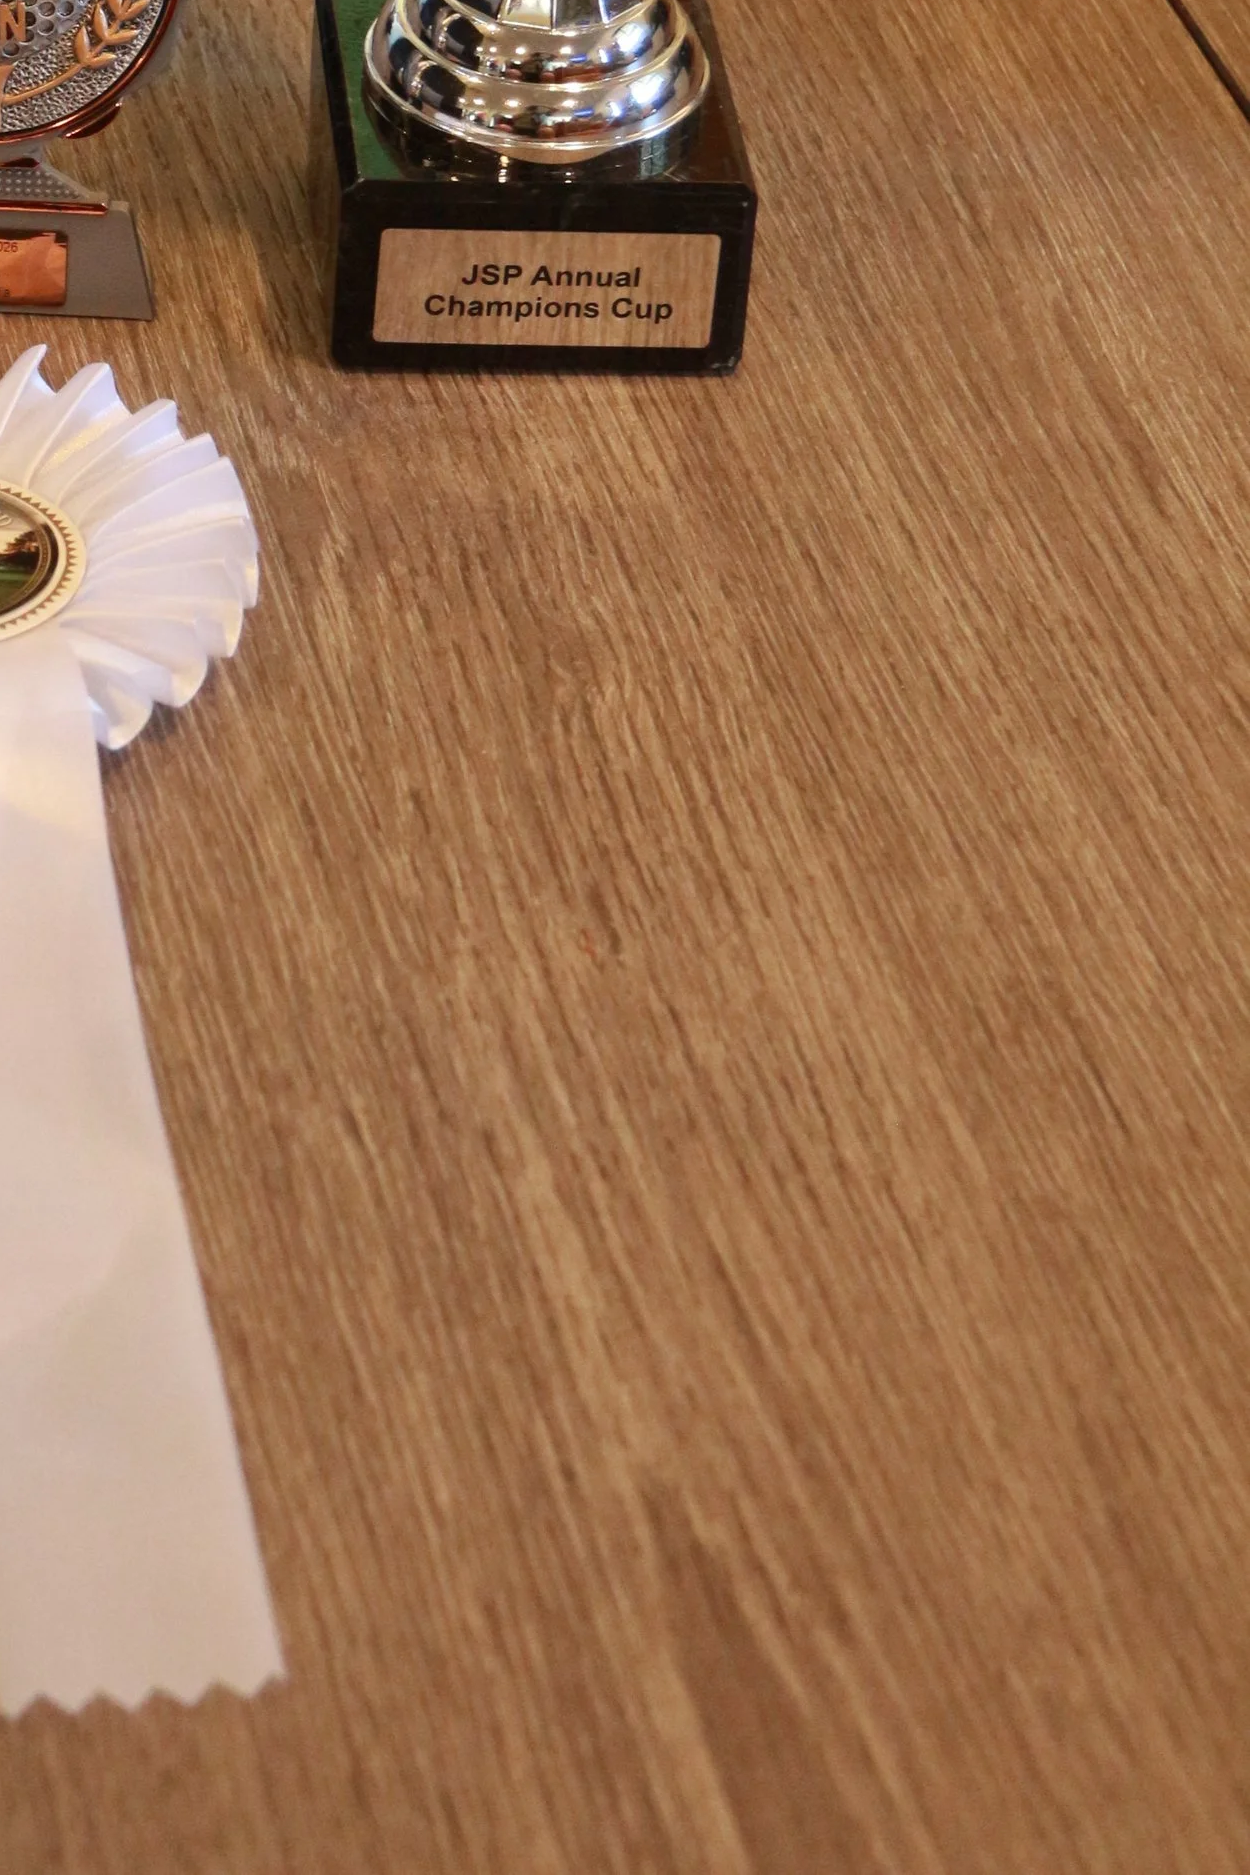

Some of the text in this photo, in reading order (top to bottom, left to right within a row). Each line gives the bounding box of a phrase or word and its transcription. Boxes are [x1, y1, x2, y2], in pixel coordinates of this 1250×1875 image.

[461, 264, 641, 288] JSP Annual
[424, 295, 673, 324] Champions Cup
